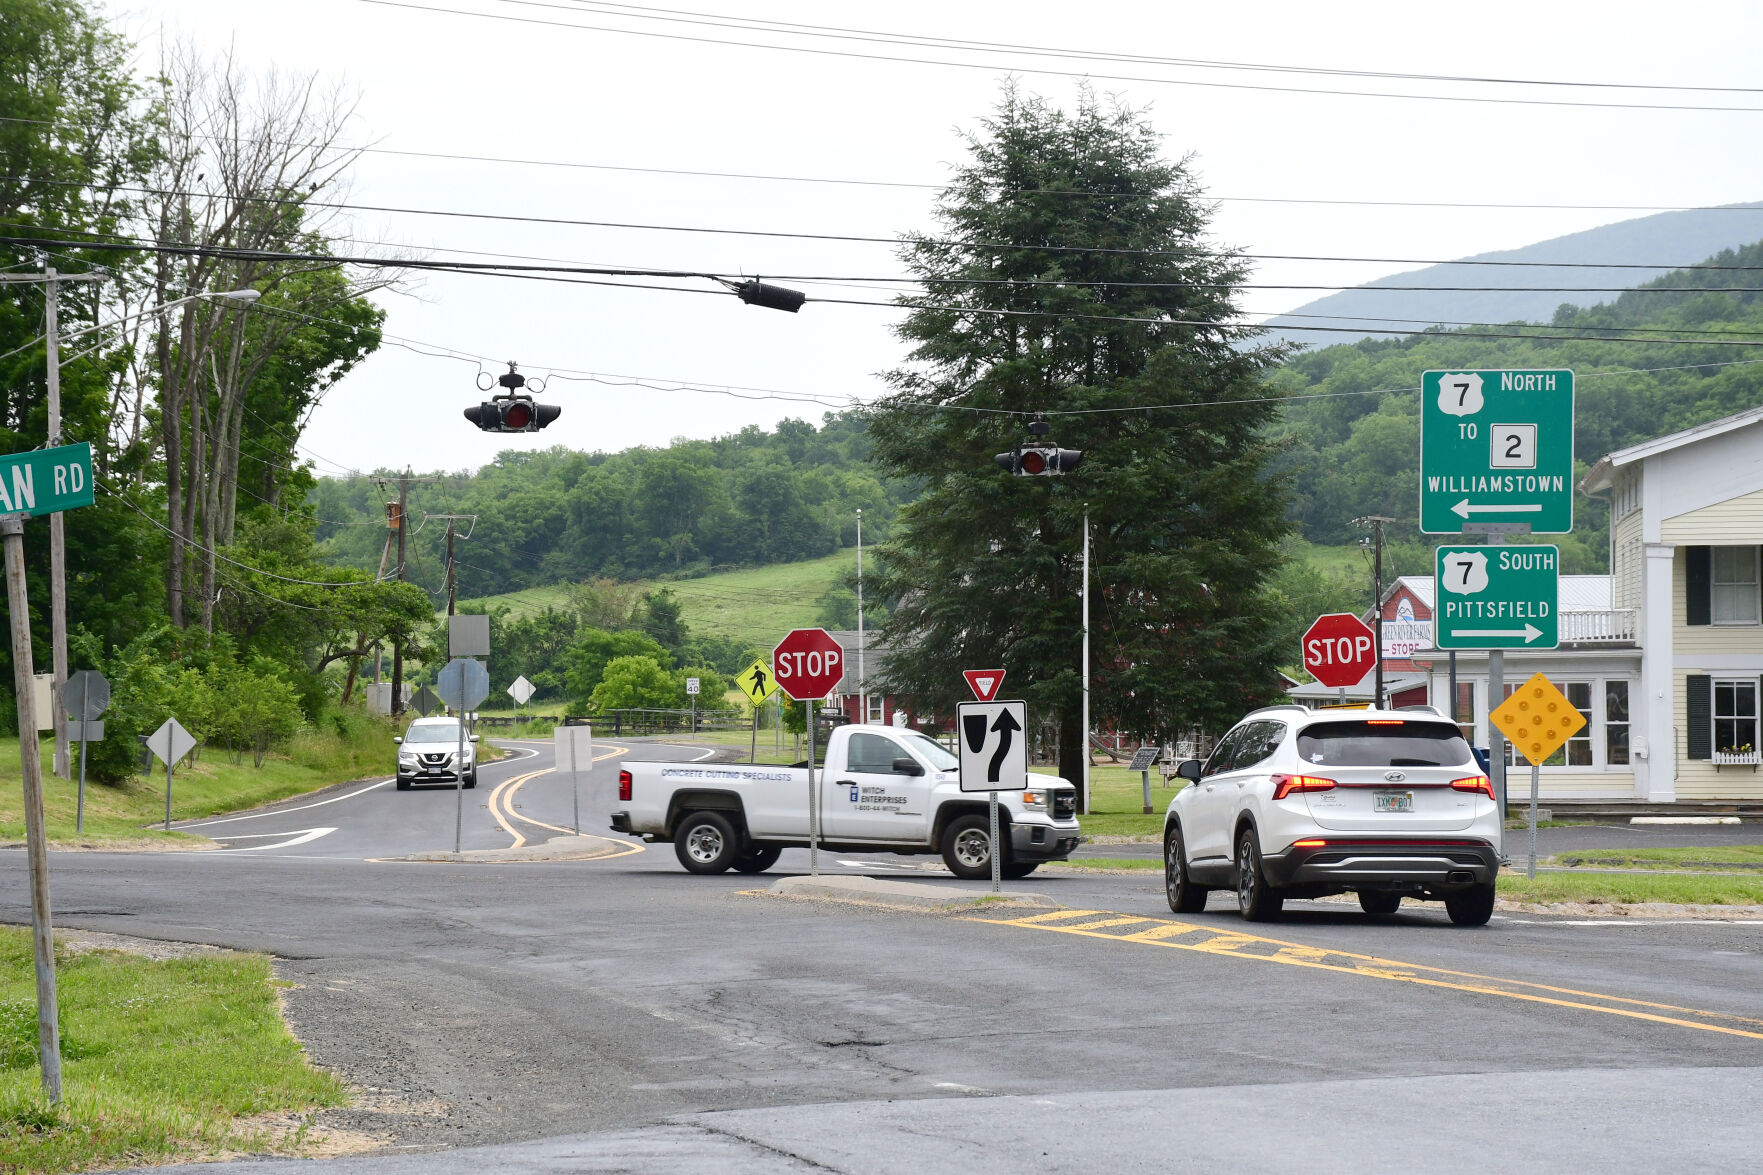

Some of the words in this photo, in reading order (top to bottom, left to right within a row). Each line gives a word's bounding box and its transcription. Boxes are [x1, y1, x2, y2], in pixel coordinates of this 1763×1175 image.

[1453, 383, 1470, 406] 7
[1501, 372, 1556, 391] NORTH
[1458, 423, 1477, 440] TO
[1505, 434, 1522, 458] 2
[54, 462, 84, 495] RD
[1428, 476, 1563, 493] WILLIAMSTOWN
[1457, 561, 1473, 585] 7
[1499, 551, 1554, 570] SOUTH
[1446, 601, 1549, 618] PITTSFIELD
[778, 650, 839, 678] STOP
[1308, 636, 1371, 666] STOP
[661, 769, 703, 777] CONCRETE
[706, 770, 739, 779] CUTTING
[743, 772, 792, 781] SPECIALISTS
[861, 796, 907, 804] ENTERPRISES
